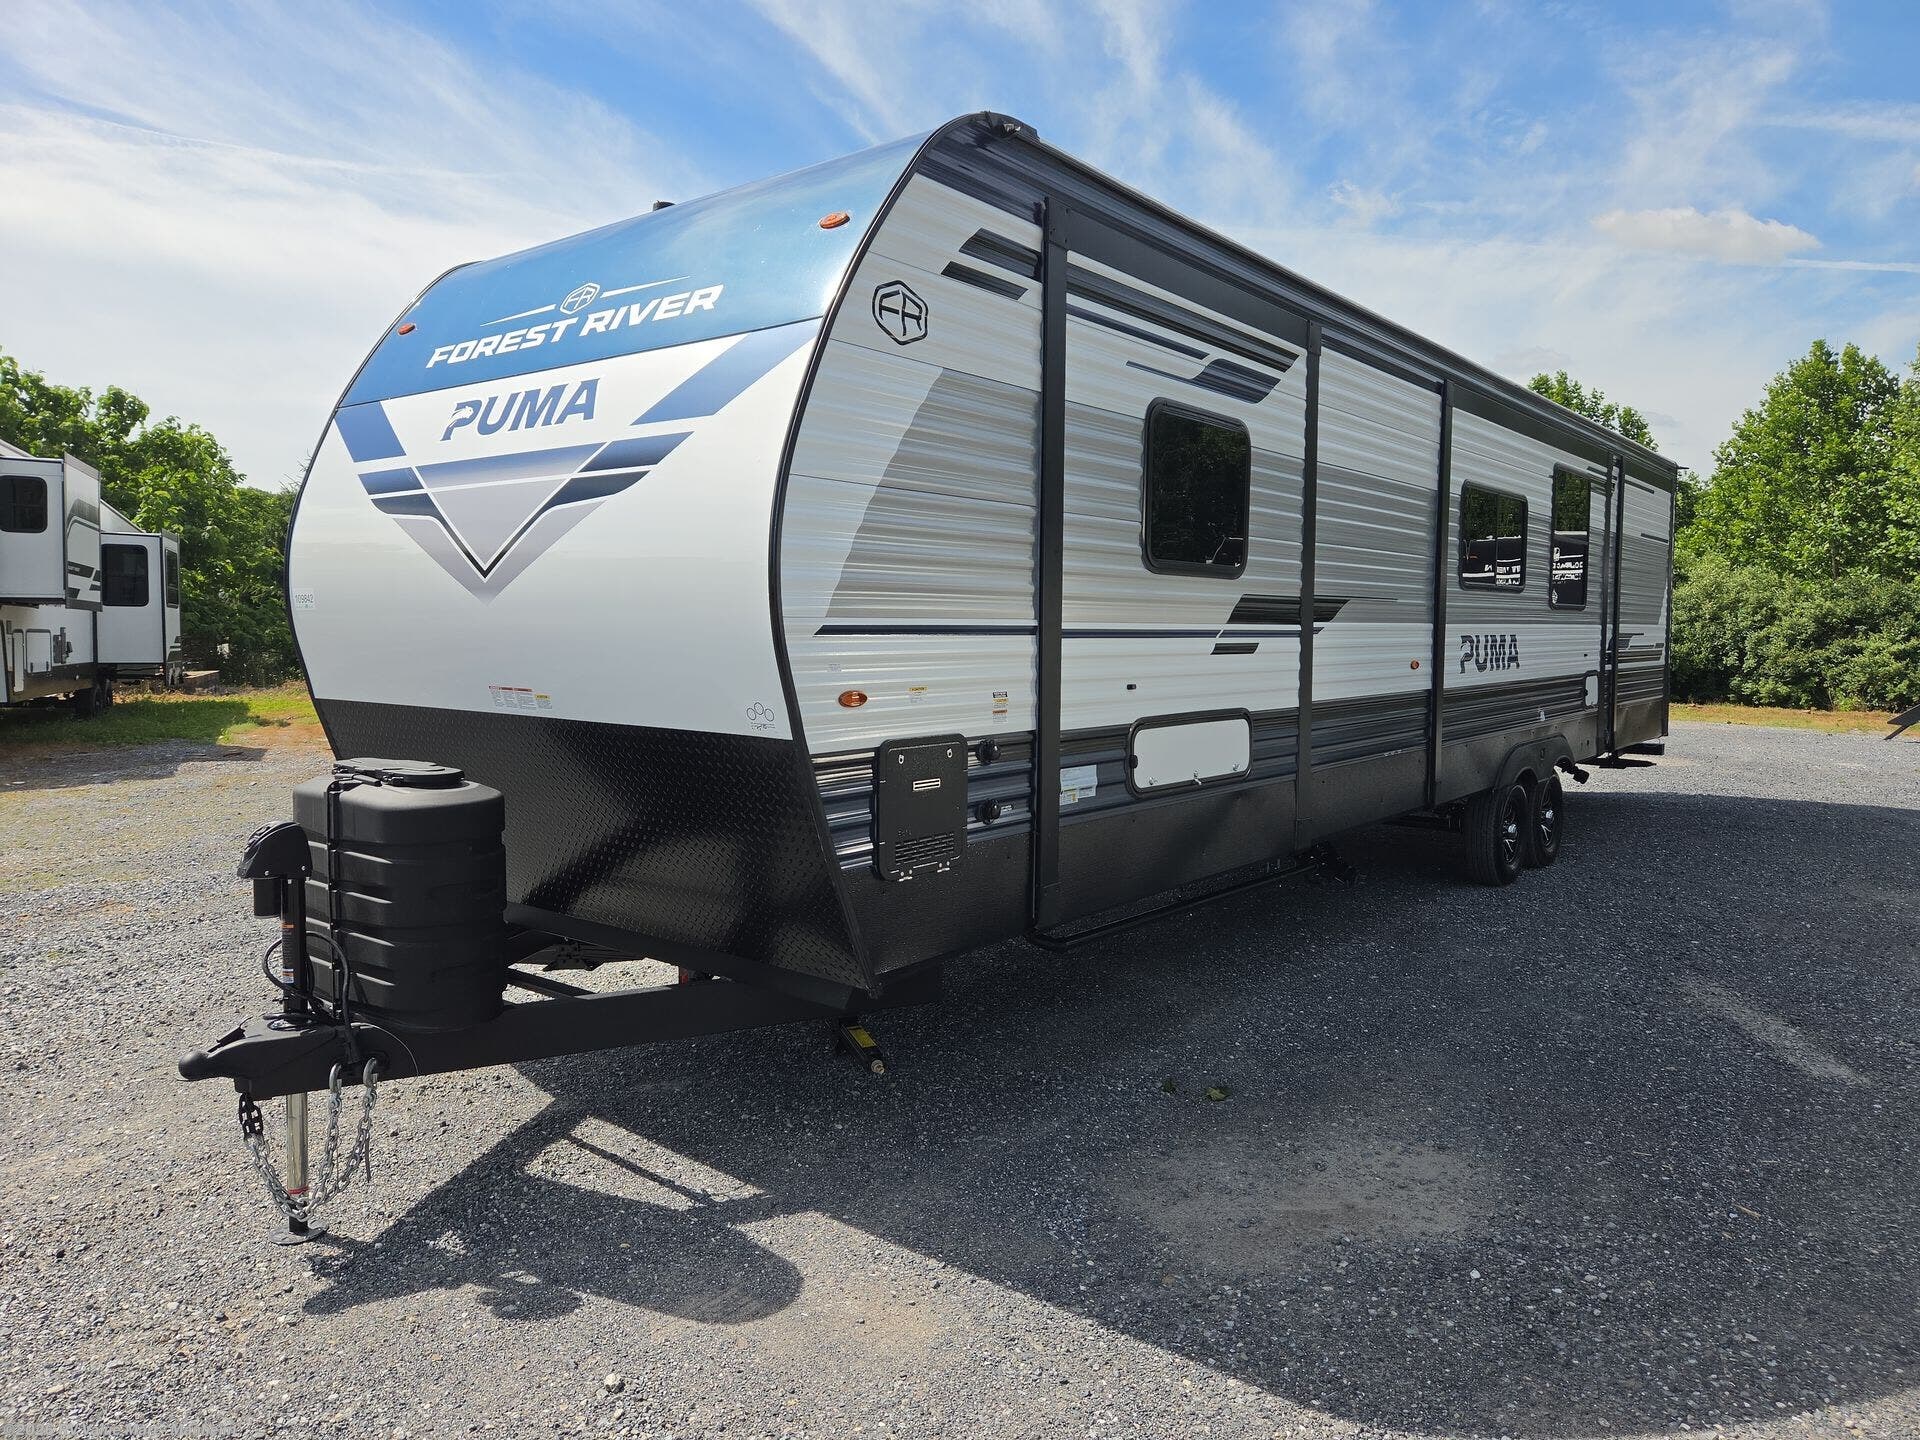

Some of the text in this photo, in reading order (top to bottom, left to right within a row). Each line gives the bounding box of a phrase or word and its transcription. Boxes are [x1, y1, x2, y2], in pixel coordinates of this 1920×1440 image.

[425, 284, 725, 369] FOREST RIVER
[440, 378, 601, 441] PUMA
[1460, 634, 1520, 674] PUMA
